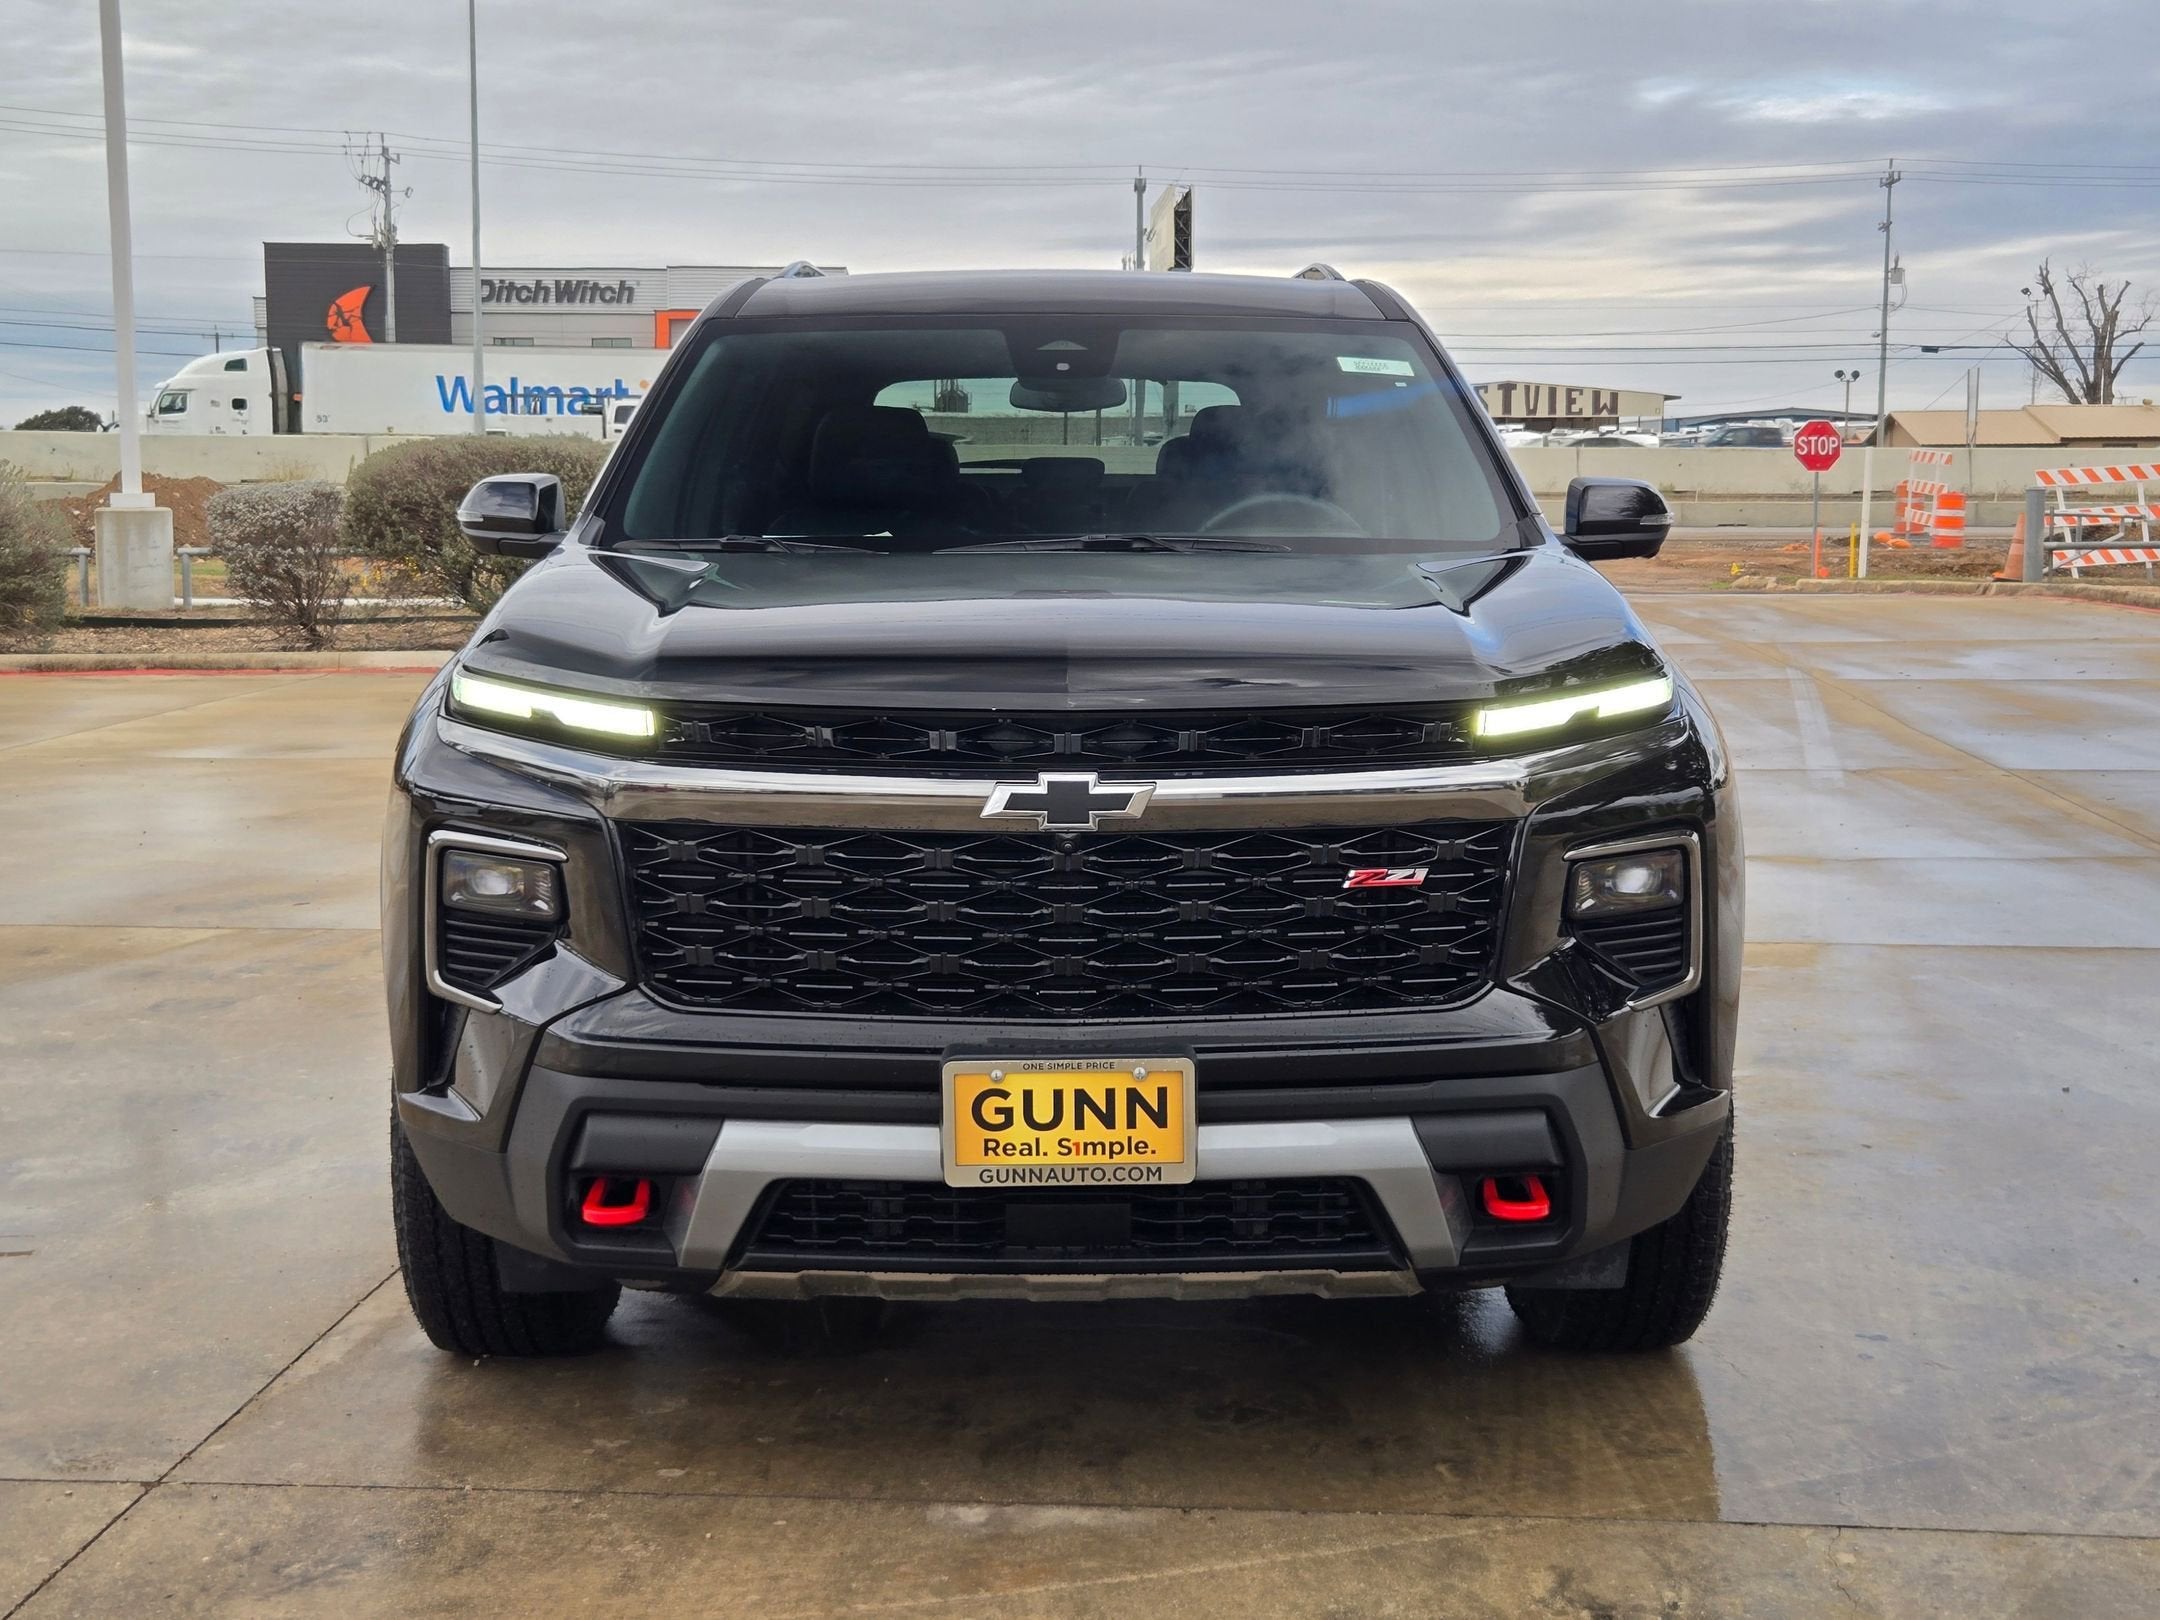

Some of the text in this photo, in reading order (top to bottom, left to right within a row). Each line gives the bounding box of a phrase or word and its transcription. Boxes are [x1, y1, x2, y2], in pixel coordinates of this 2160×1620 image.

[481, 279, 635, 304] Ditch Witch
[435, 375, 630, 416] Walmart
[1796, 436, 1839, 456] STOP
[1343, 868, 1429, 888] Z71
[1022, 1061, 1115, 1071] ONE SIMPLE PRICE
[971, 1086, 1168, 1132] GUNN
[983, 1138, 1048, 1157] Real.
[979, 1167, 1162, 1184] GUNNAUTO.COM
